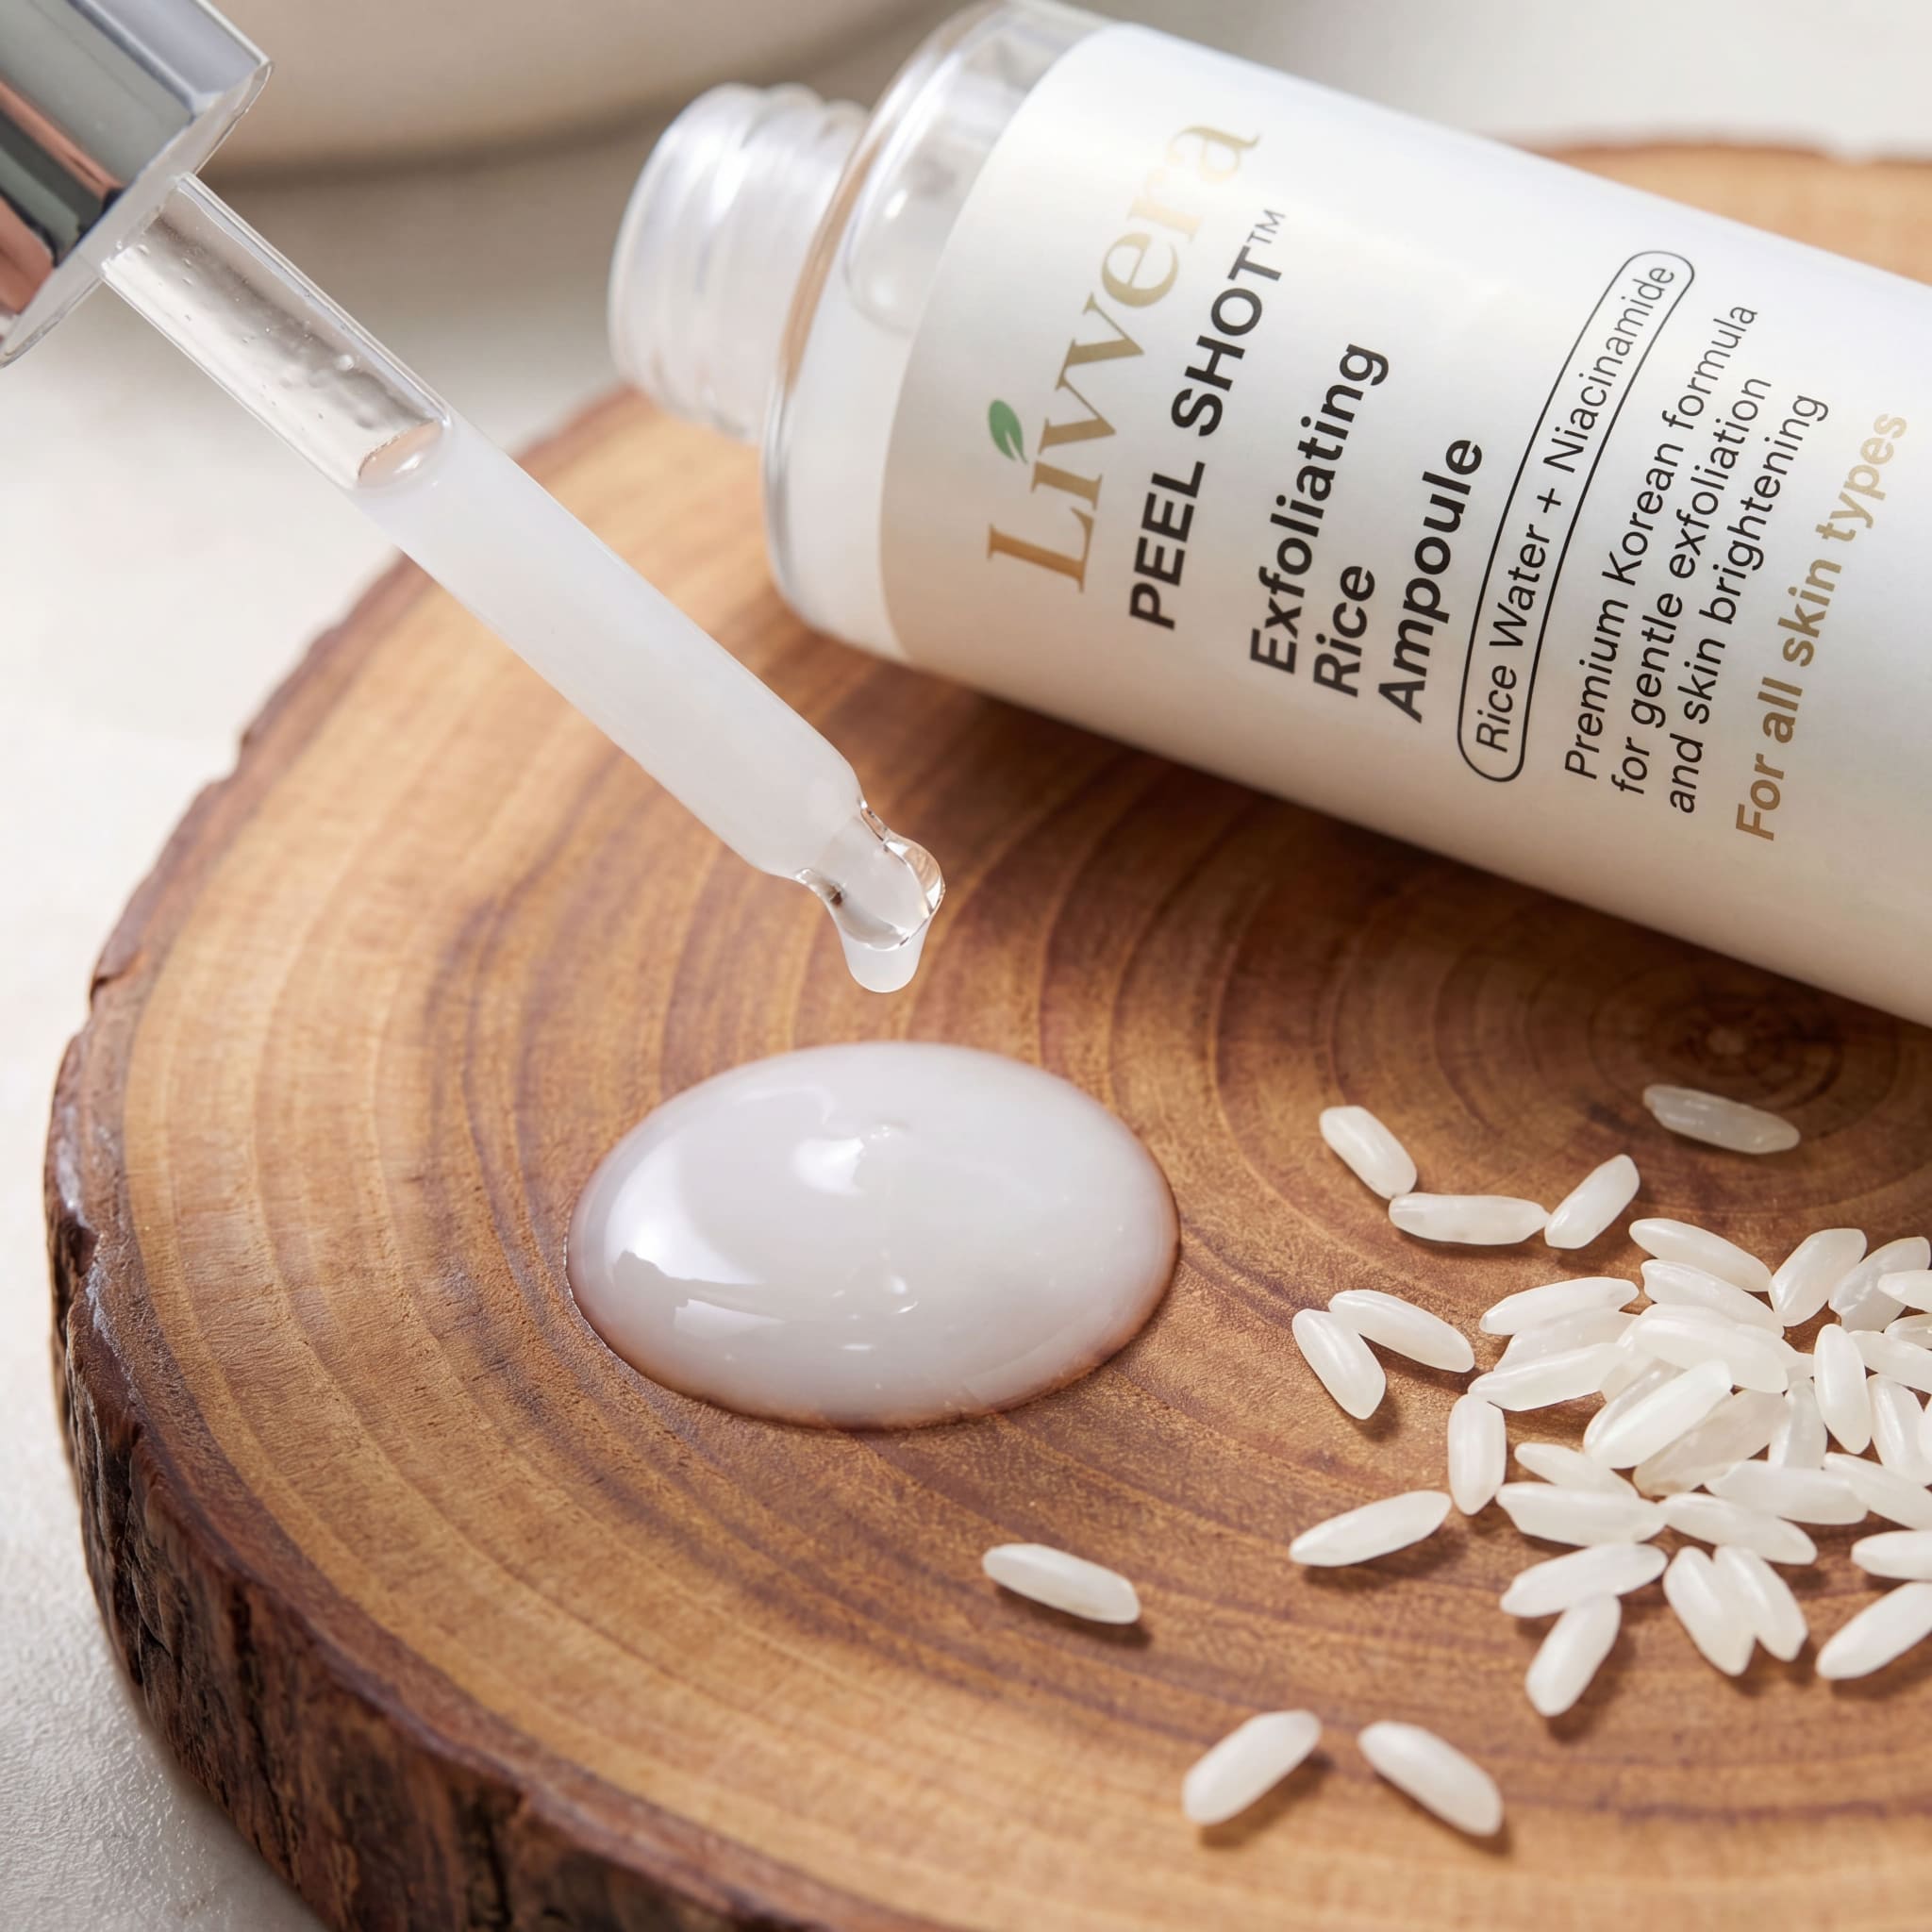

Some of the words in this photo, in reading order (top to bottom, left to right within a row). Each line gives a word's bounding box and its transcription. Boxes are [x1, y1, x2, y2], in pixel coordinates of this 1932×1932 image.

[1541, 265, 1676, 475] Niacinamide
[1248, 342, 1390, 675] Exfoliating
[1536, 487, 1562, 514] +
[1563, 598, 1629, 781] Premium
[1600, 441, 1685, 587] Korean
[1660, 305, 1759, 432] formula
[1668, 377, 1773, 579] exfoliation
[1697, 391, 1830, 625] brightening
[1814, 411, 1908, 547] types
[1127, 459, 1207, 632] PEEL
[1376, 439, 1483, 724] Ampoule
[1488, 523, 1551, 647] Water
[1312, 565, 1376, 699] Rice
[1630, 592, 1684, 729] gentle
[1776, 557, 1843, 669] skin
[1474, 664, 1518, 754] Rice
[1676, 637, 1726, 726] skin
[1757, 676, 1804, 745] all
[1610, 735, 1651, 796] for
[1669, 732, 1705, 814] and
[1734, 753, 1786, 841] For
